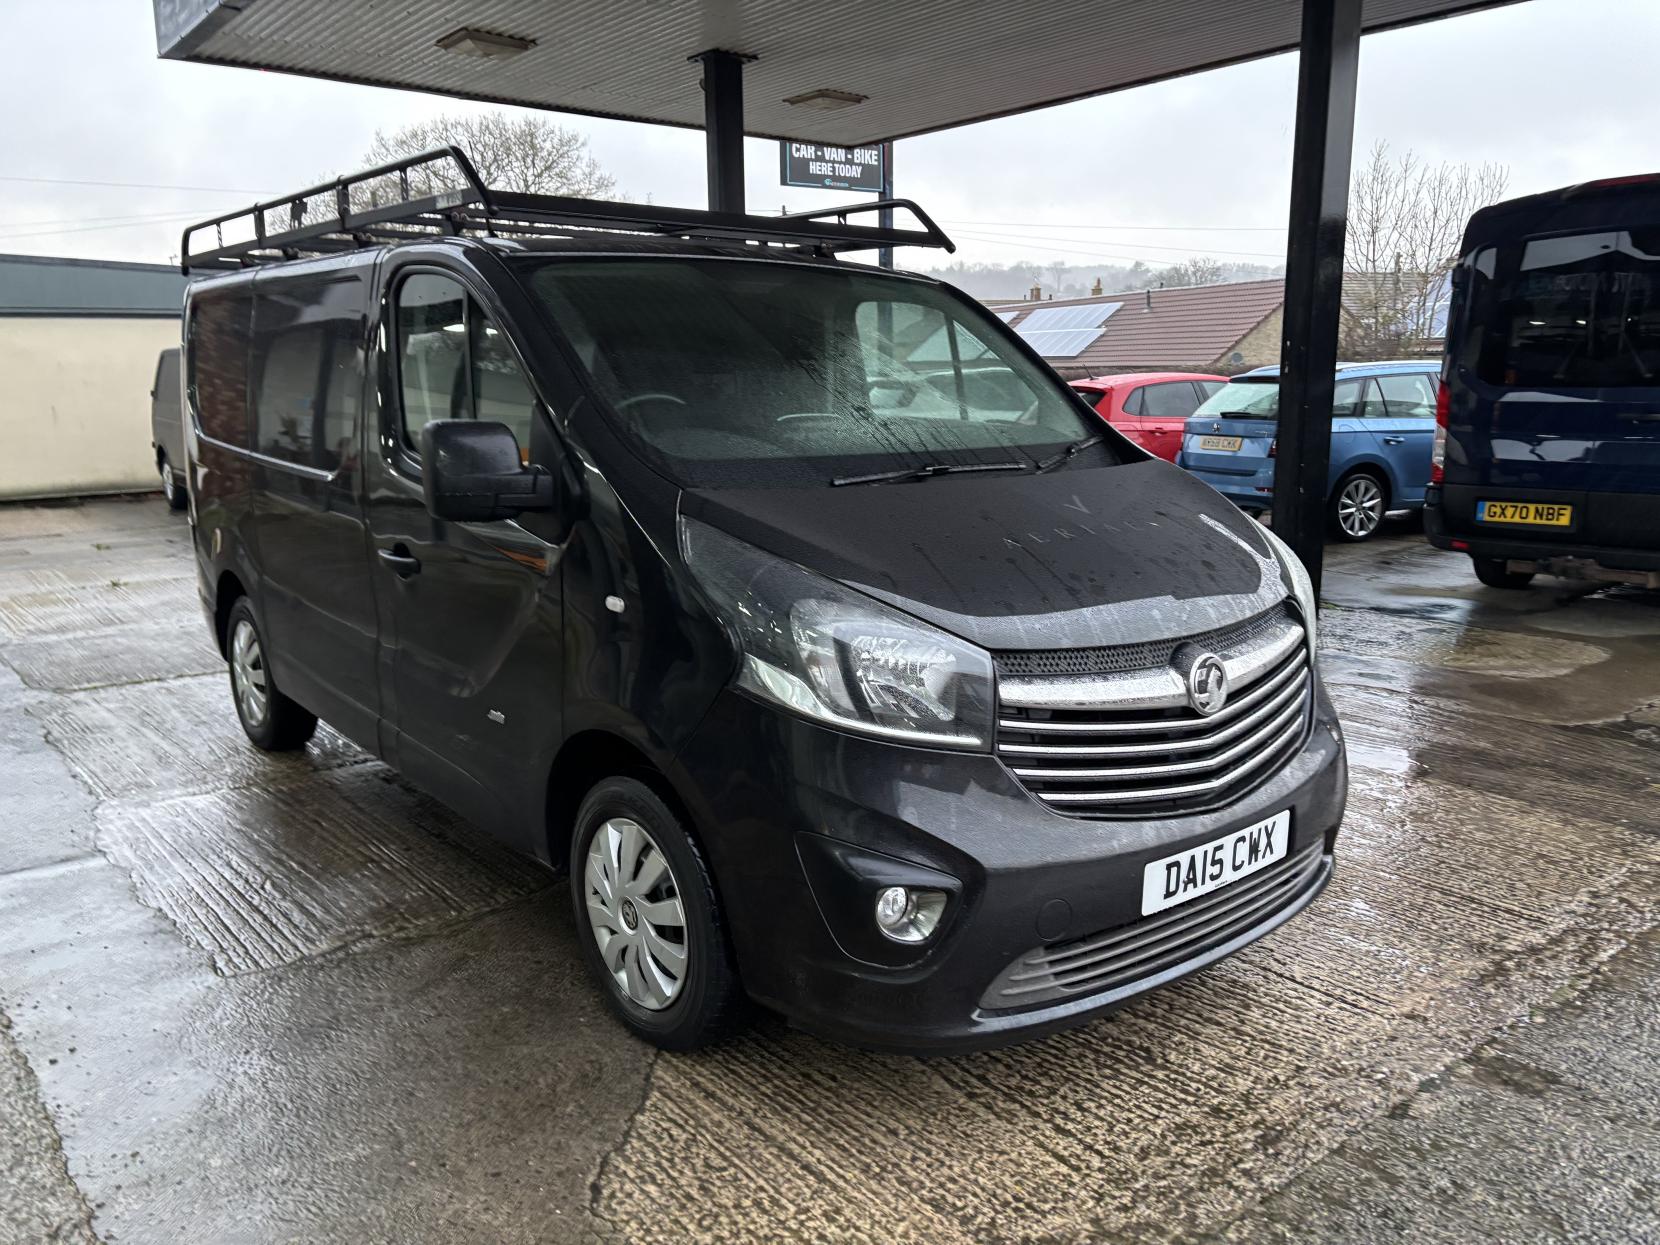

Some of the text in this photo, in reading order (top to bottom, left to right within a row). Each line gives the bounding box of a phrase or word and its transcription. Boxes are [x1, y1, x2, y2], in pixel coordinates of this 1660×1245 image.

[792, 143, 815, 159] CAR
[823, 147, 846, 162] VAN
[854, 149, 878, 165] BIKE
[809, 161, 863, 178] HERE TODAY
[1487, 504, 1568, 521] GX70 NBF
[1163, 820, 1277, 900] DA15 CWX
